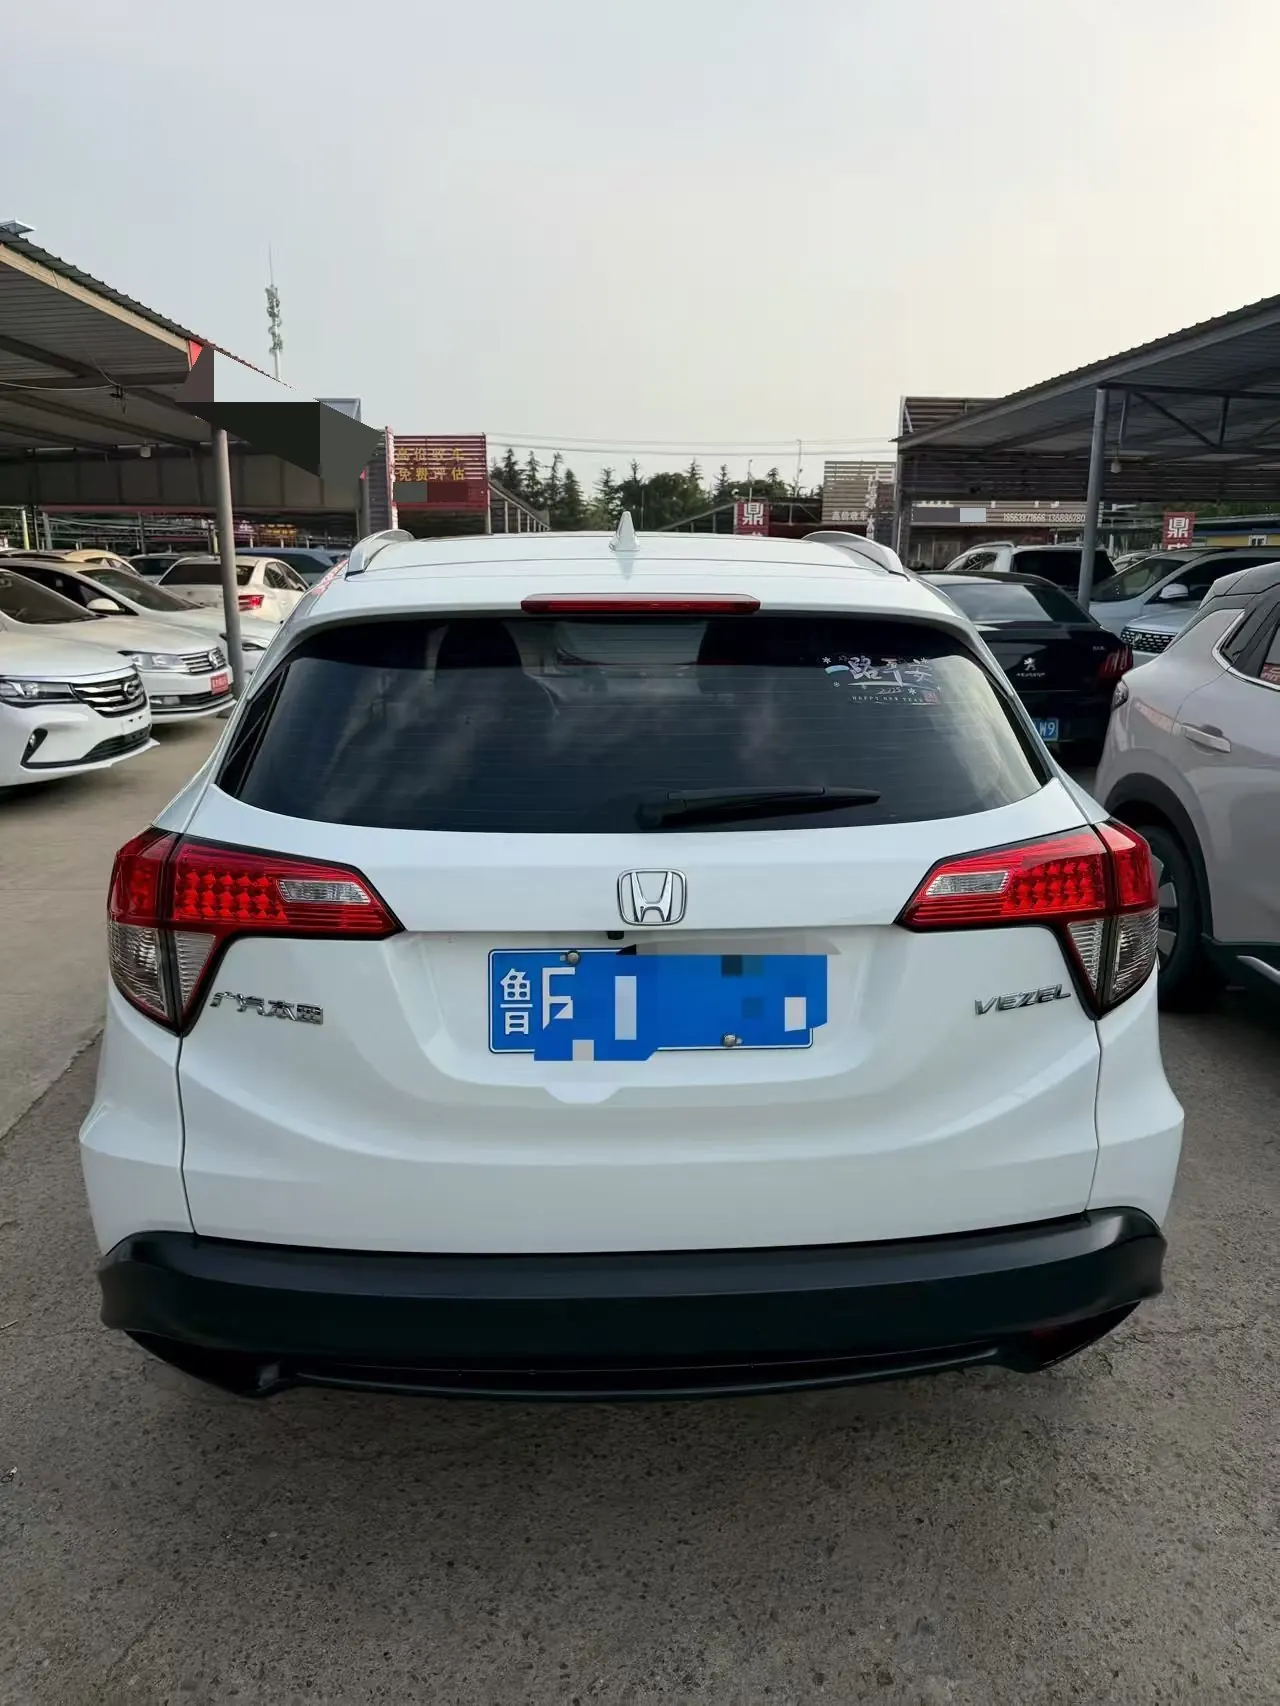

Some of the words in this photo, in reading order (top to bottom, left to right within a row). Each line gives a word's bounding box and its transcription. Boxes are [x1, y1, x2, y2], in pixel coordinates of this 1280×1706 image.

[397, 467, 465, 481] 免费评估
[742, 502, 764, 536] 鼎
[1167, 517, 1189, 549] 鼎
[975, 983, 1072, 1015] VEZEL
